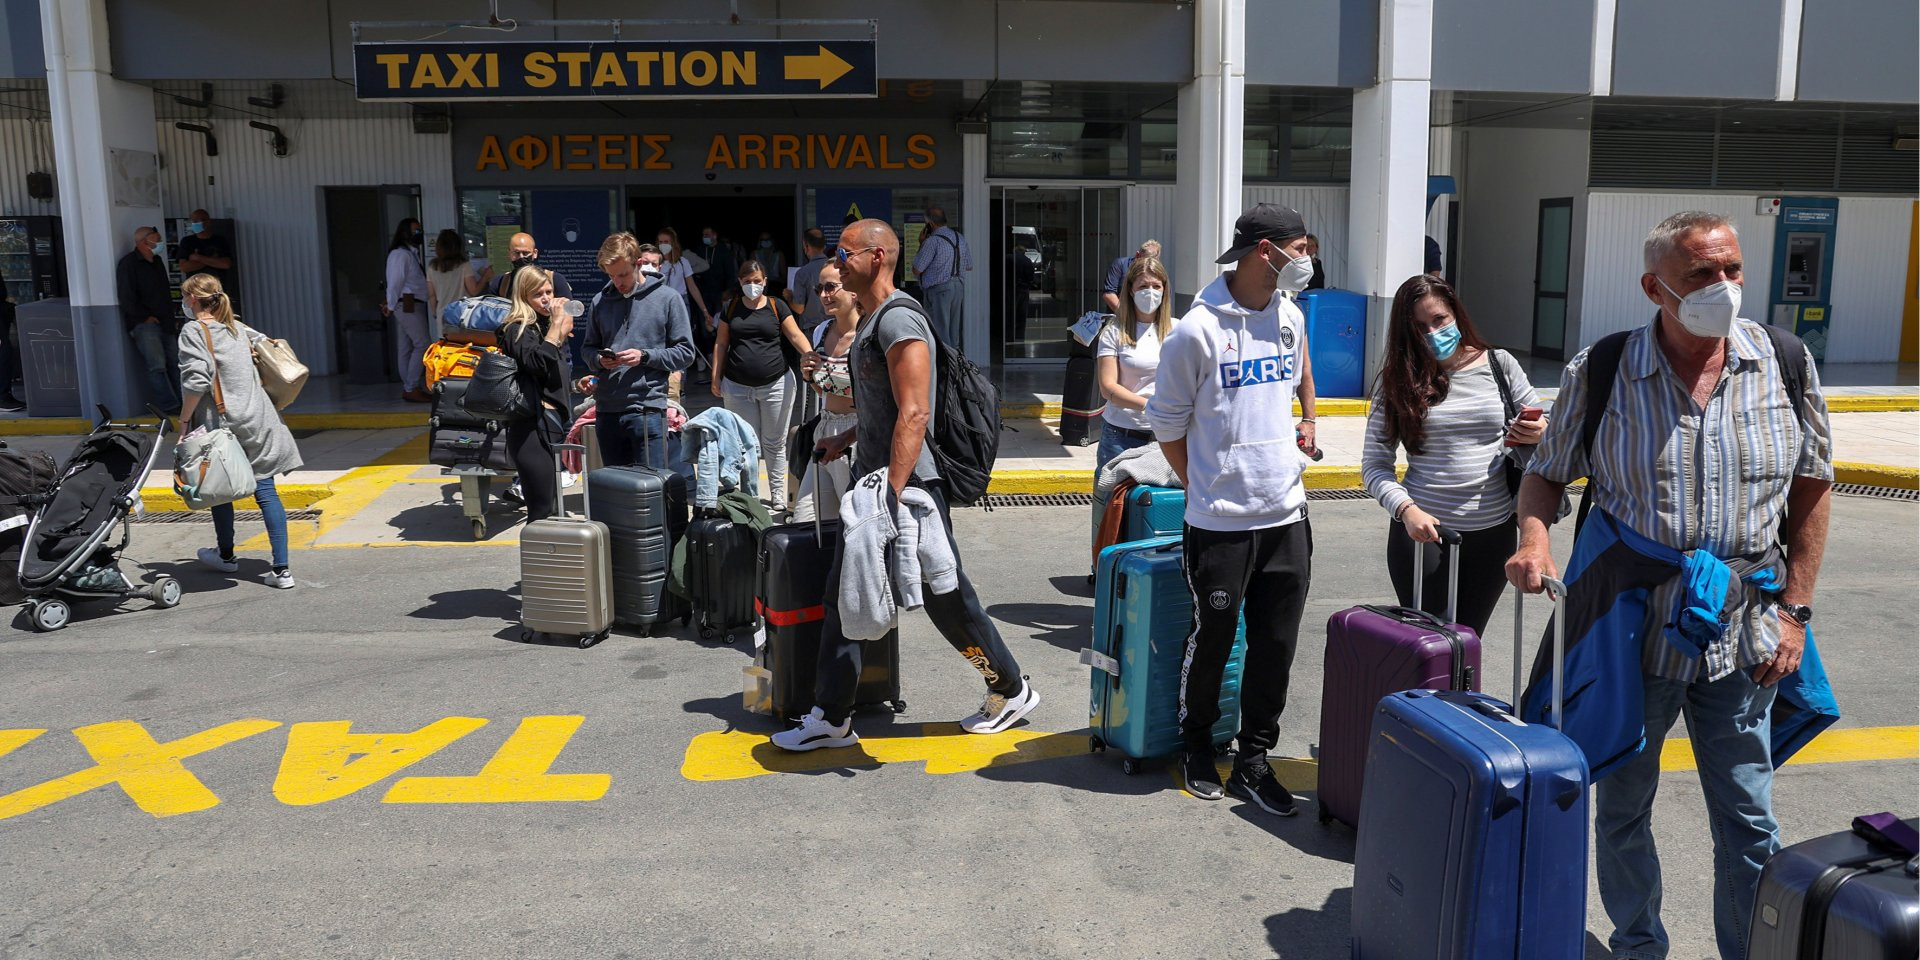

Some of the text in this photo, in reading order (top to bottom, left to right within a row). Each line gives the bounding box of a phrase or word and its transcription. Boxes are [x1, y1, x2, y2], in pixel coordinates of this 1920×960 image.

[376, 50, 757, 89] TAXI STATION
[476, 134, 673, 171] ΑΦΙΞΕΙΣ
[705, 133, 936, 170] ARRIVALS
[1223, 356, 1293, 387] PARIS
[0, 715, 612, 819] TAX
